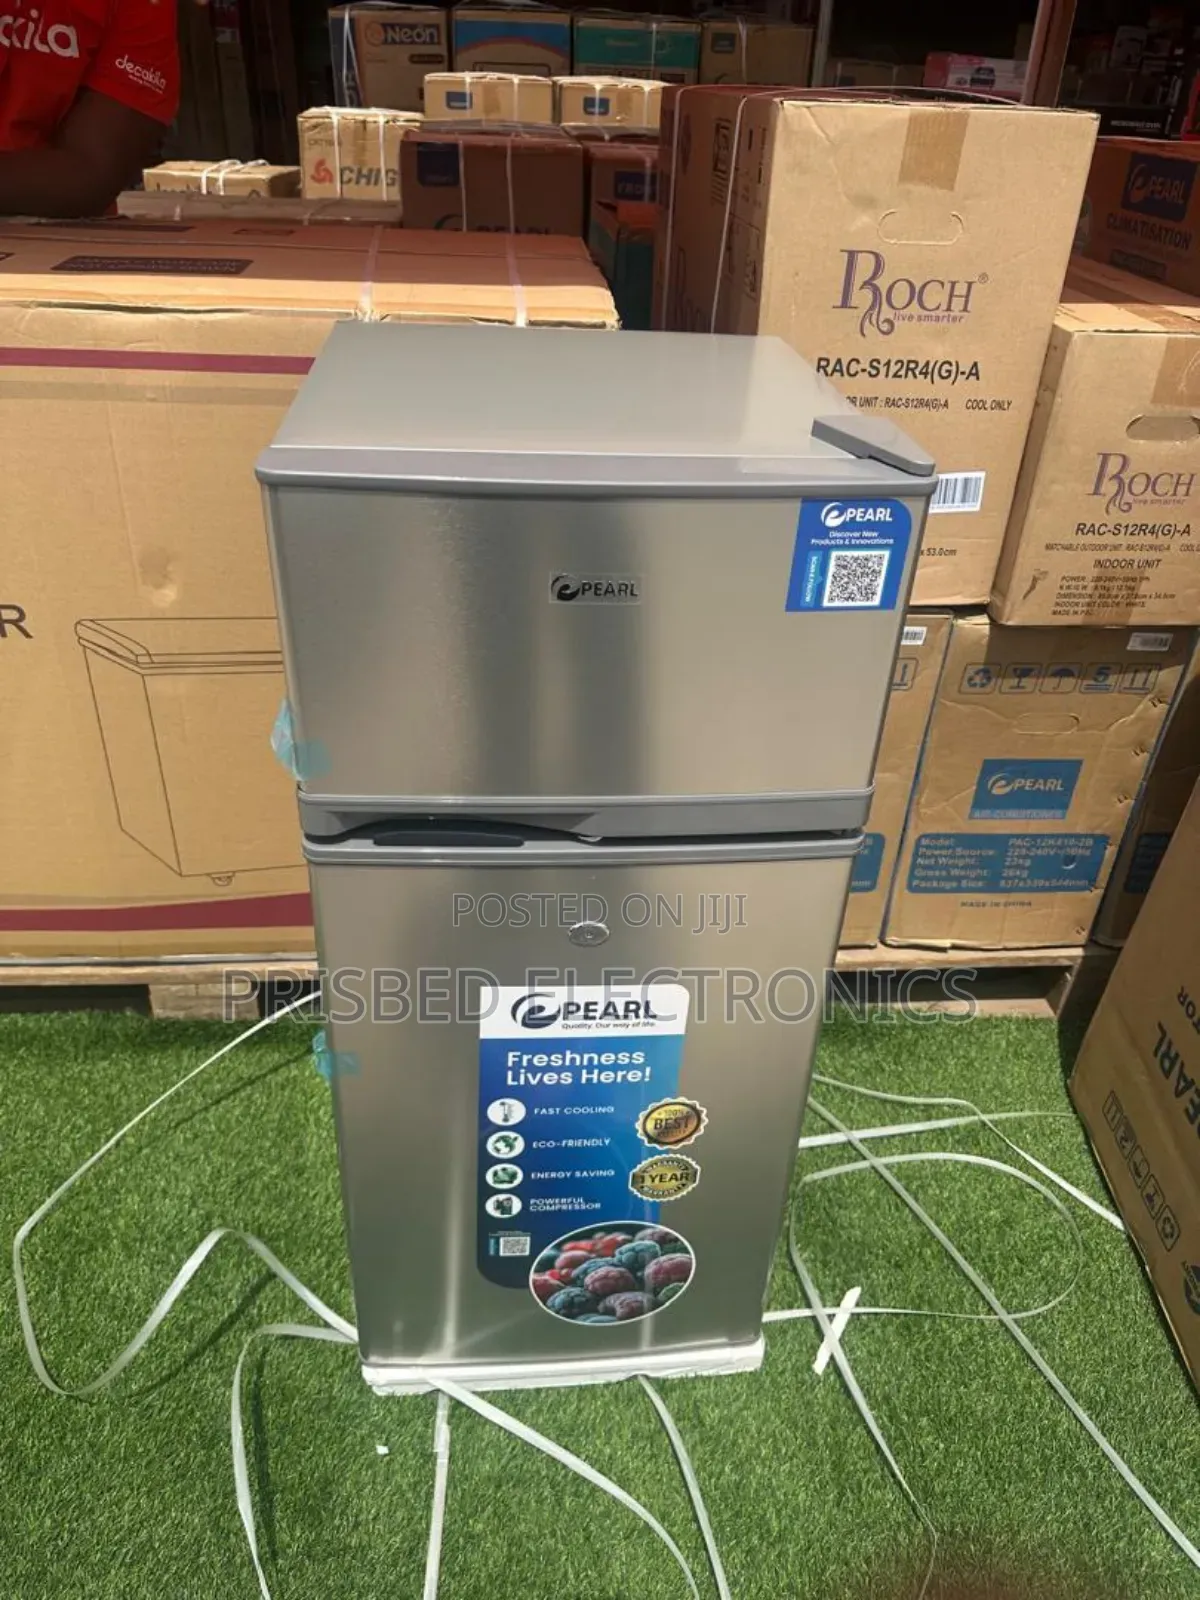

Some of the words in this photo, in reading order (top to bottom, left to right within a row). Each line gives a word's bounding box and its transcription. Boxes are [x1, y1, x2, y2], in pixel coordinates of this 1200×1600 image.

[1149, 176, 1185, 204] PEARL
[893, 311, 914, 322] live
[917, 312, 964, 323] smarter
[816, 357, 981, 385] RAC-S12R4(G)-A
[859, 396, 879, 408] UNIT
[966, 399, 986, 410] COOL
[991, 400, 1012, 411] ONLY
[1085, 453, 1197, 515] ROCH
[846, 507, 893, 523] PEARL
[829, 530, 860, 538] Discover
[1075, 523, 1191, 540] RAC-S12R4(G)-A
[811, 538, 843, 546] Products
[1093, 559, 1134, 569] INDOOR
[1137, 559, 1162, 569] UNIT
[581, 581, 639, 598] PEARL
[1013, 778, 1065, 792] PEARL
[563, 1000, 658, 1022] PEARL
[507, 1050, 646, 1068] Freshness
[506, 1069, 573, 1086] Lives
[581, 1066, 652, 1084] Here!
[1153, 1020, 1200, 1136] EARL
[534, 1107, 561, 1115] FAST
[564, 1106, 615, 1114] COOLING
[532, 1138, 611, 1149] ECO-FRIENDLY
[575, 1169, 615, 1177] SAVING
[649, 1172, 690, 1184] YEAR
[529, 1203, 601, 1212] COMPRESSOR
[530, 1197, 584, 1205] POWERFUL
